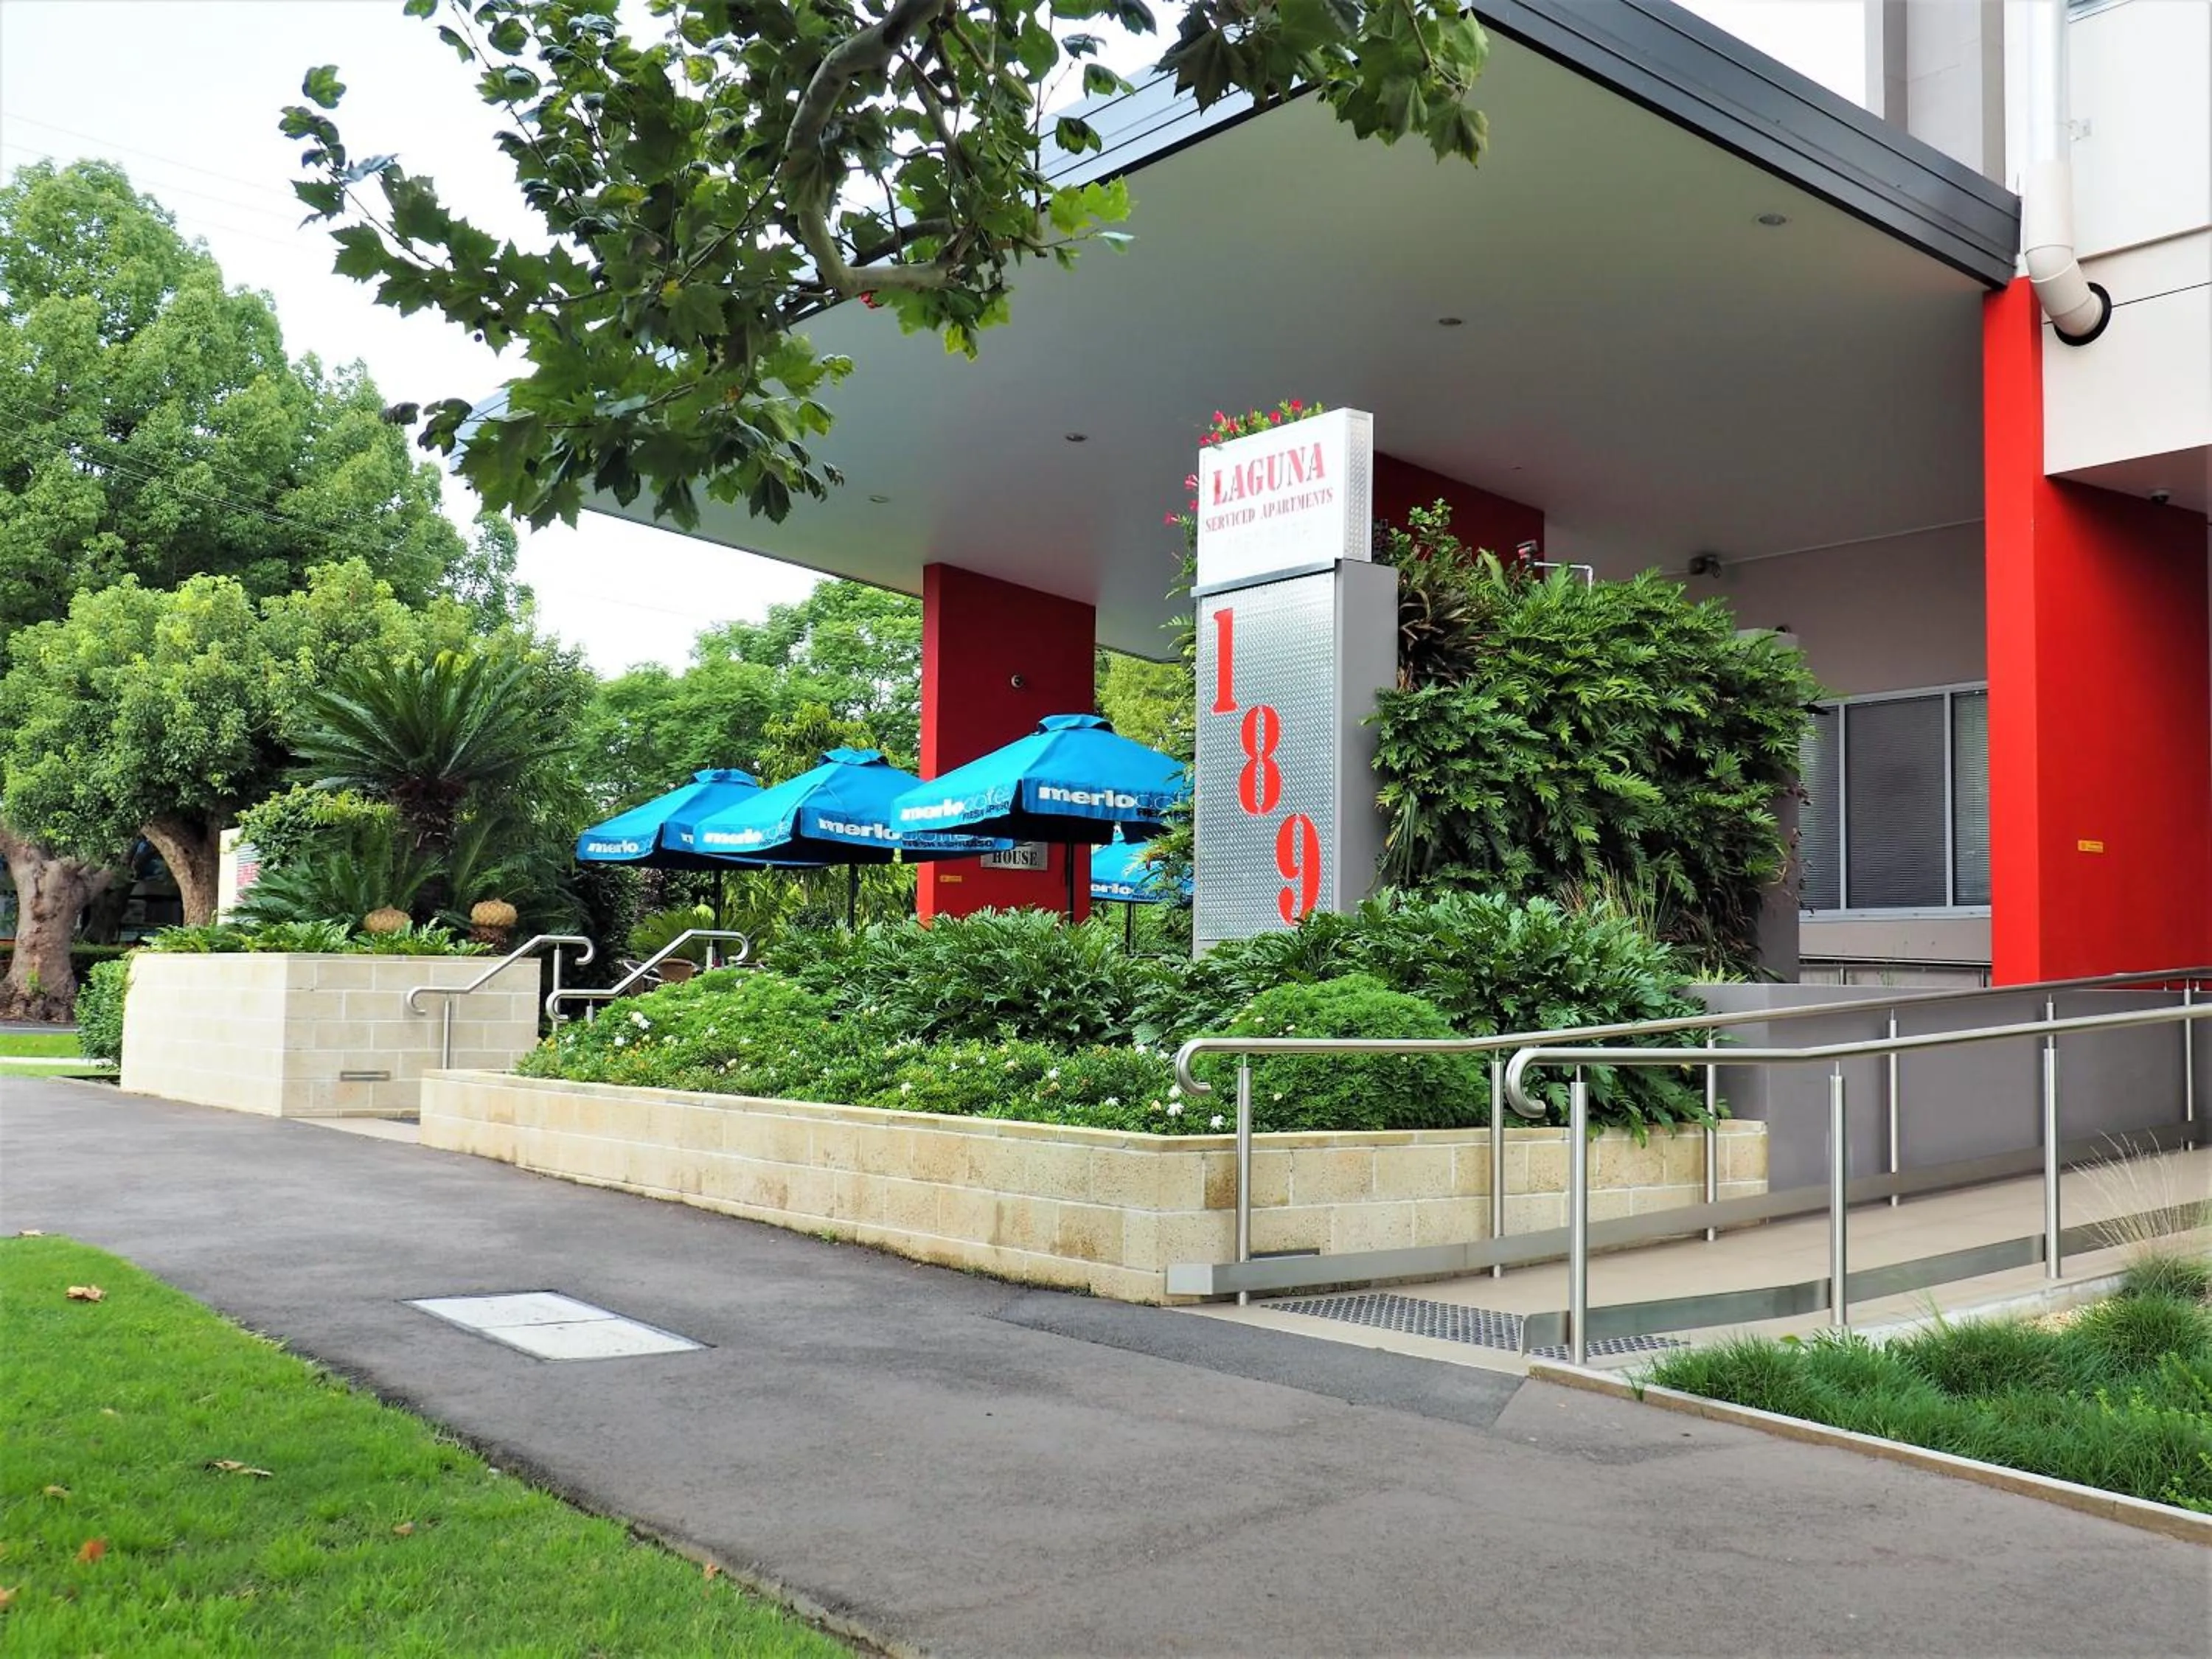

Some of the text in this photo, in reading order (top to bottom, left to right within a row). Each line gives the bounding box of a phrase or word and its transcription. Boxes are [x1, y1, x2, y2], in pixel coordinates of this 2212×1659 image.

[1213, 442, 1326, 506] LAGUNA
[1205, 487, 1333, 532] SERVICED APARTMENTS
[587, 839, 639, 853] merlo
[992, 850, 1039, 866] HOUSE
[1091, 883, 1133, 895] erlo
